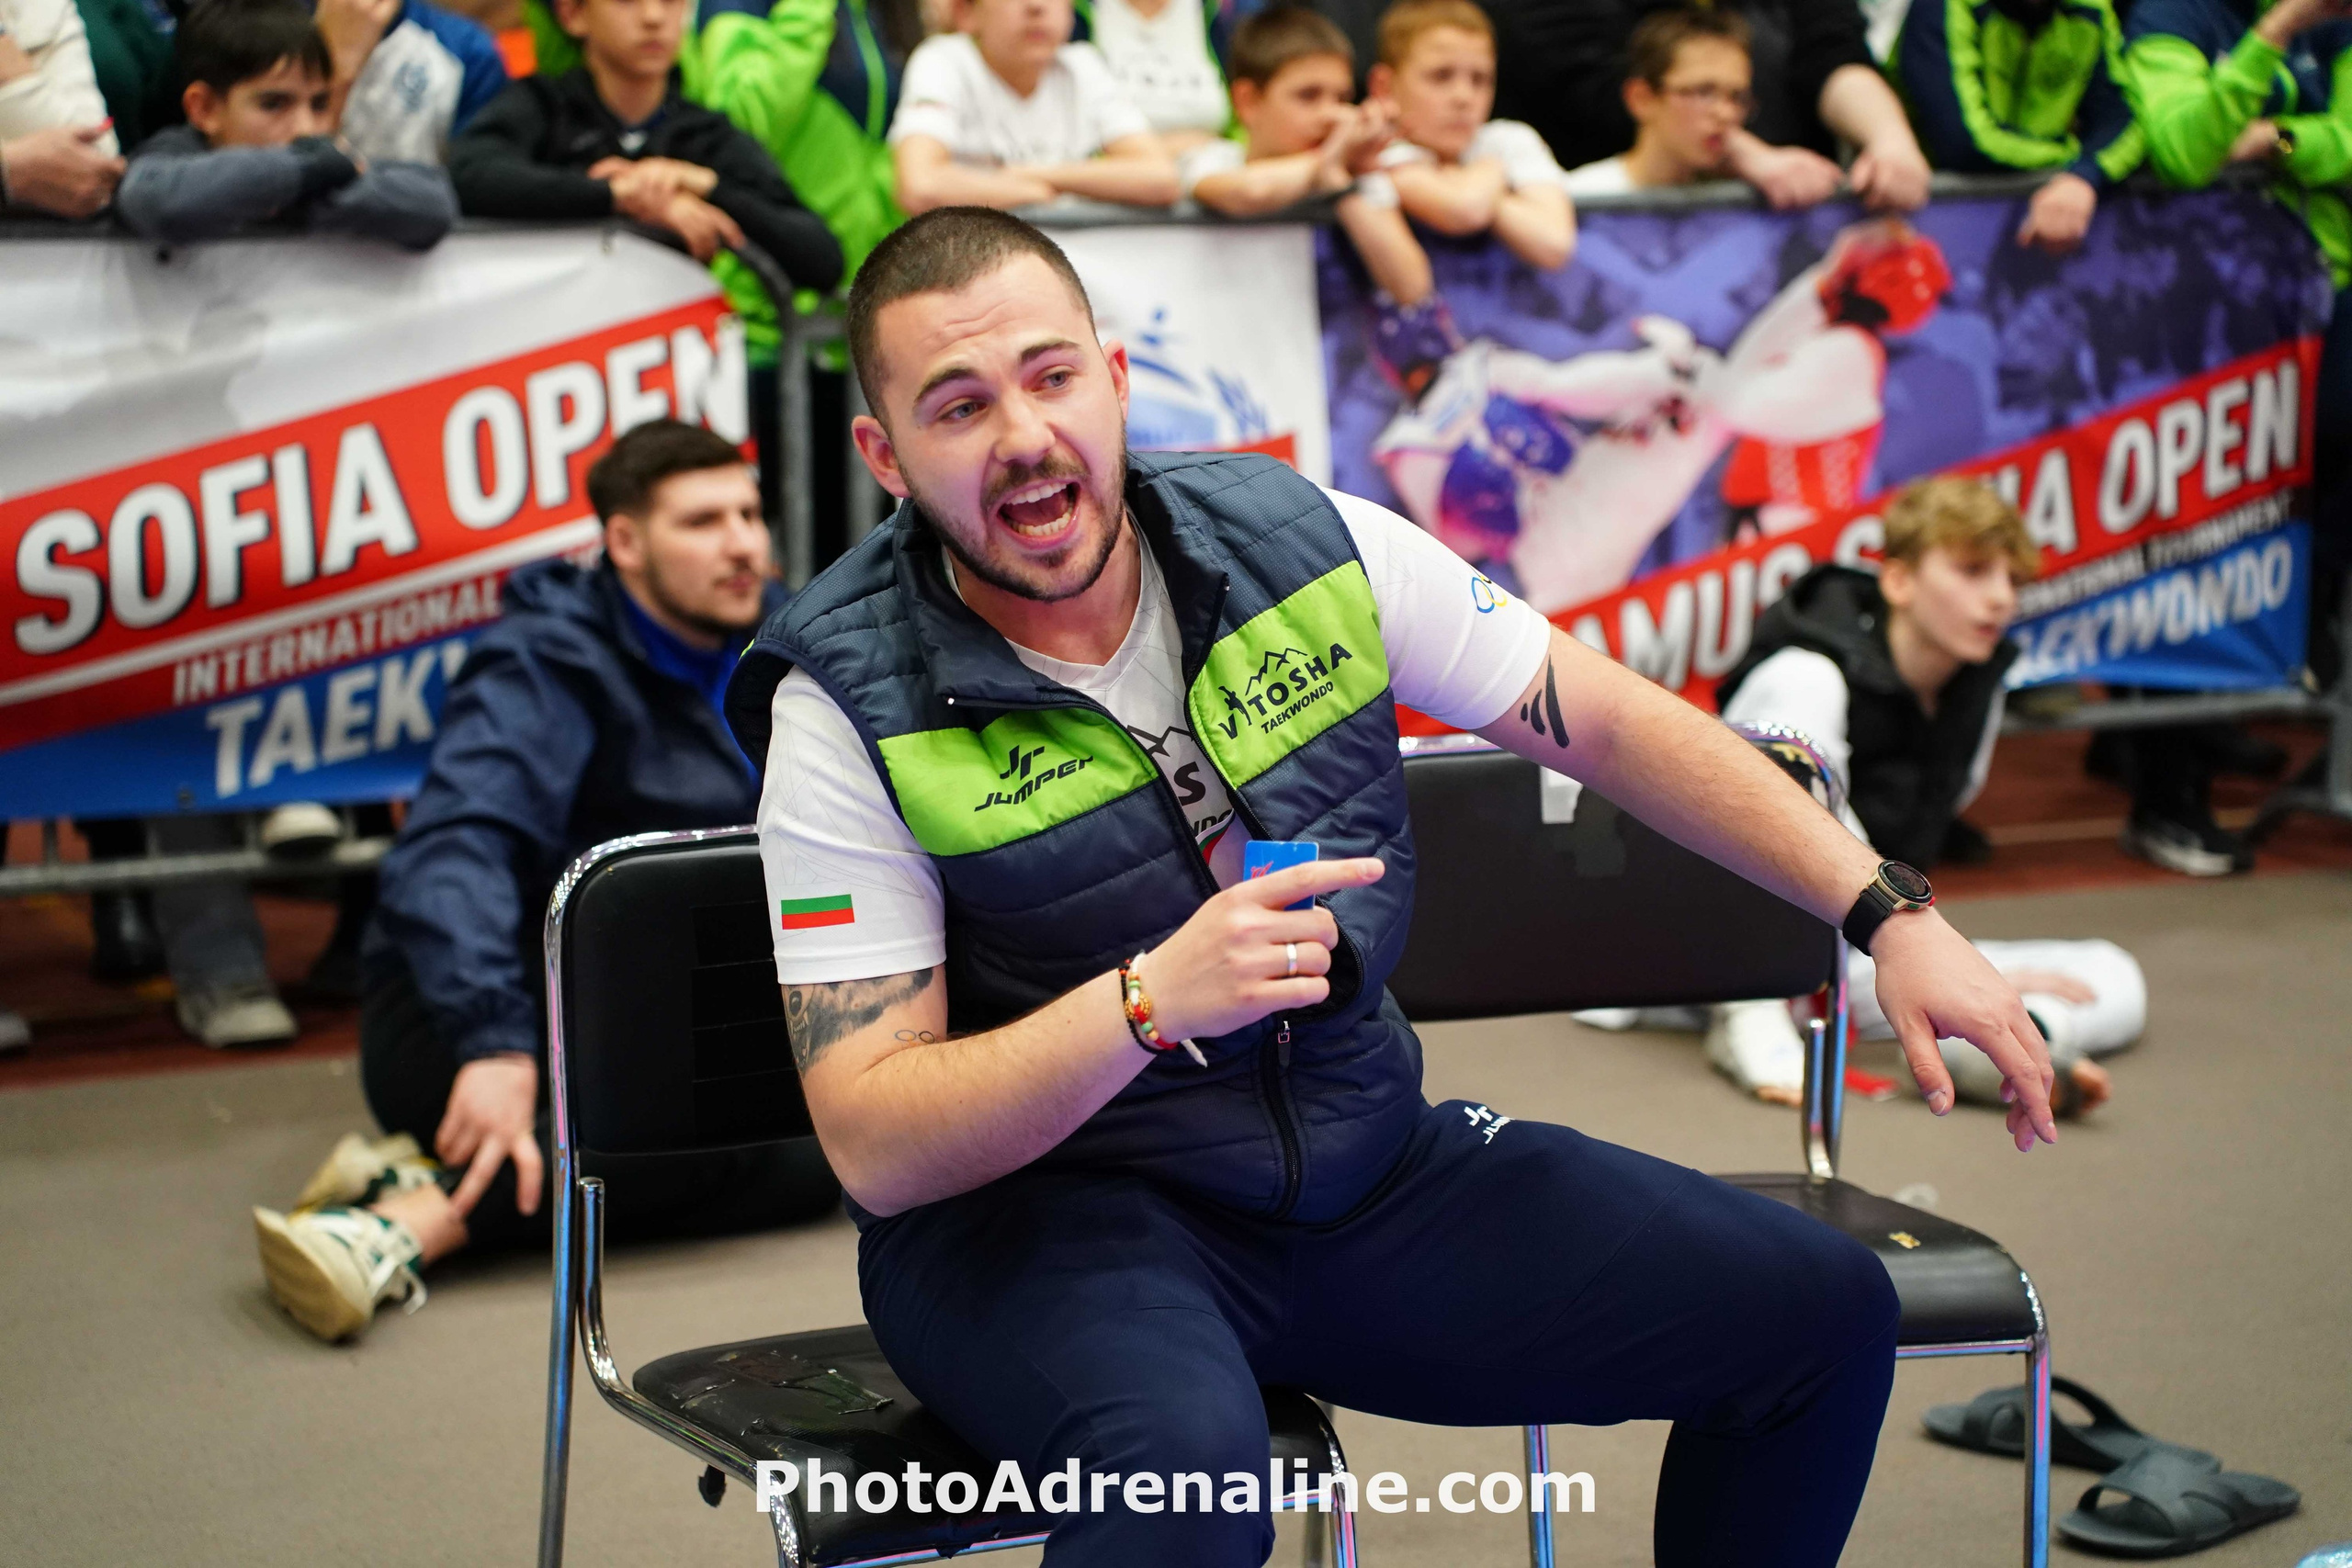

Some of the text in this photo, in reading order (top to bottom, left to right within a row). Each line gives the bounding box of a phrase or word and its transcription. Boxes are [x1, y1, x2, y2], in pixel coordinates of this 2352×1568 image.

[14, 312, 750, 657] SOFIA OPEN
[2098, 357, 2300, 535] OPEN
[173, 573, 501, 707] INTERNATIONAL
[1261, 681, 1334, 734] TAEKWONDO
